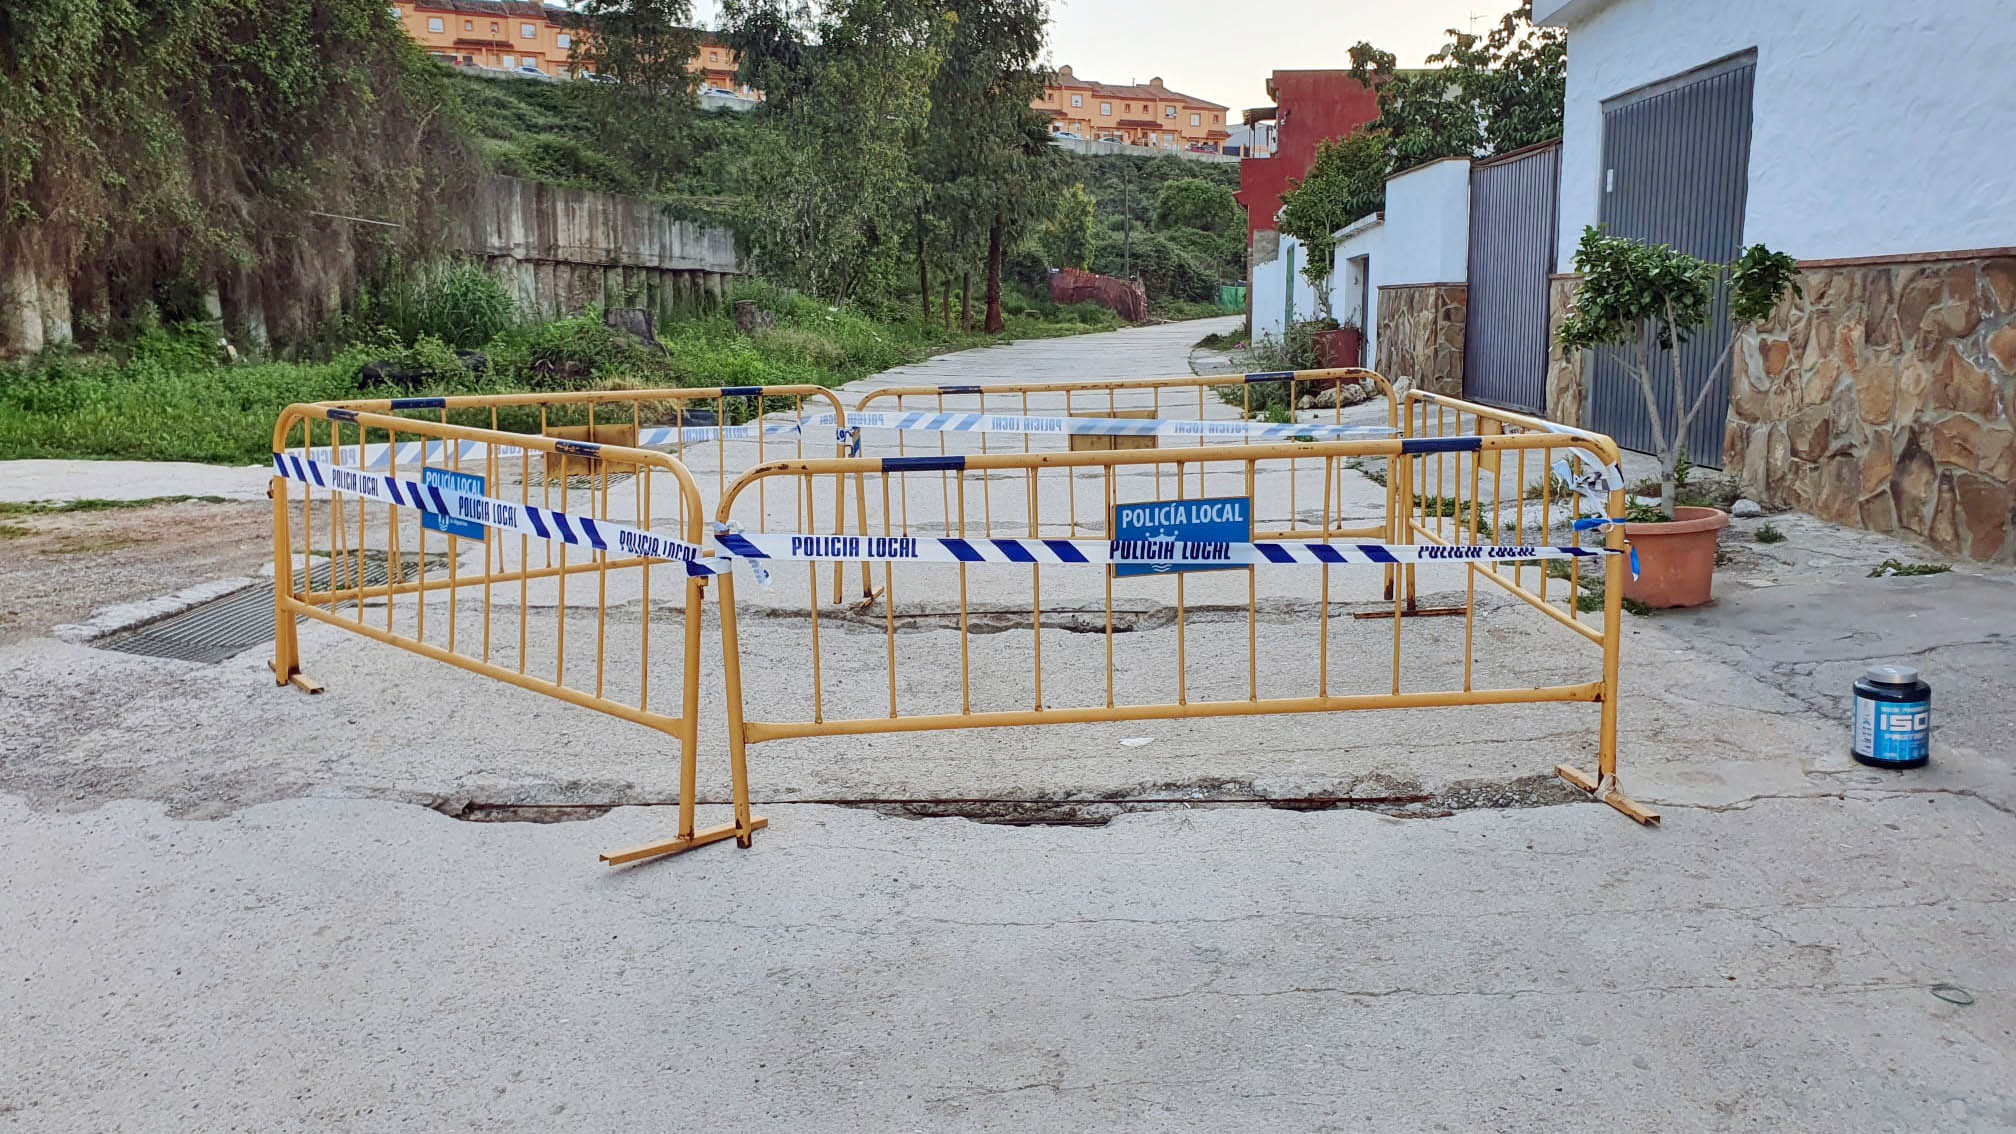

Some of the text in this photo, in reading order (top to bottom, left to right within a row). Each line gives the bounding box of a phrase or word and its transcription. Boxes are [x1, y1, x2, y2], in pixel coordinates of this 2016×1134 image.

[332, 469, 379, 497] POLICIA LOCAL
[457, 477, 481, 494] LOCAL
[459, 496, 518, 528] POLICIA LOCAL
[1122, 503, 1243, 528] POLICÍA LOCAL
[619, 530, 659, 557] POLICIA
[792, 536, 918, 558] POLICIA LOCAL
[1880, 712, 1928, 731] ISO
